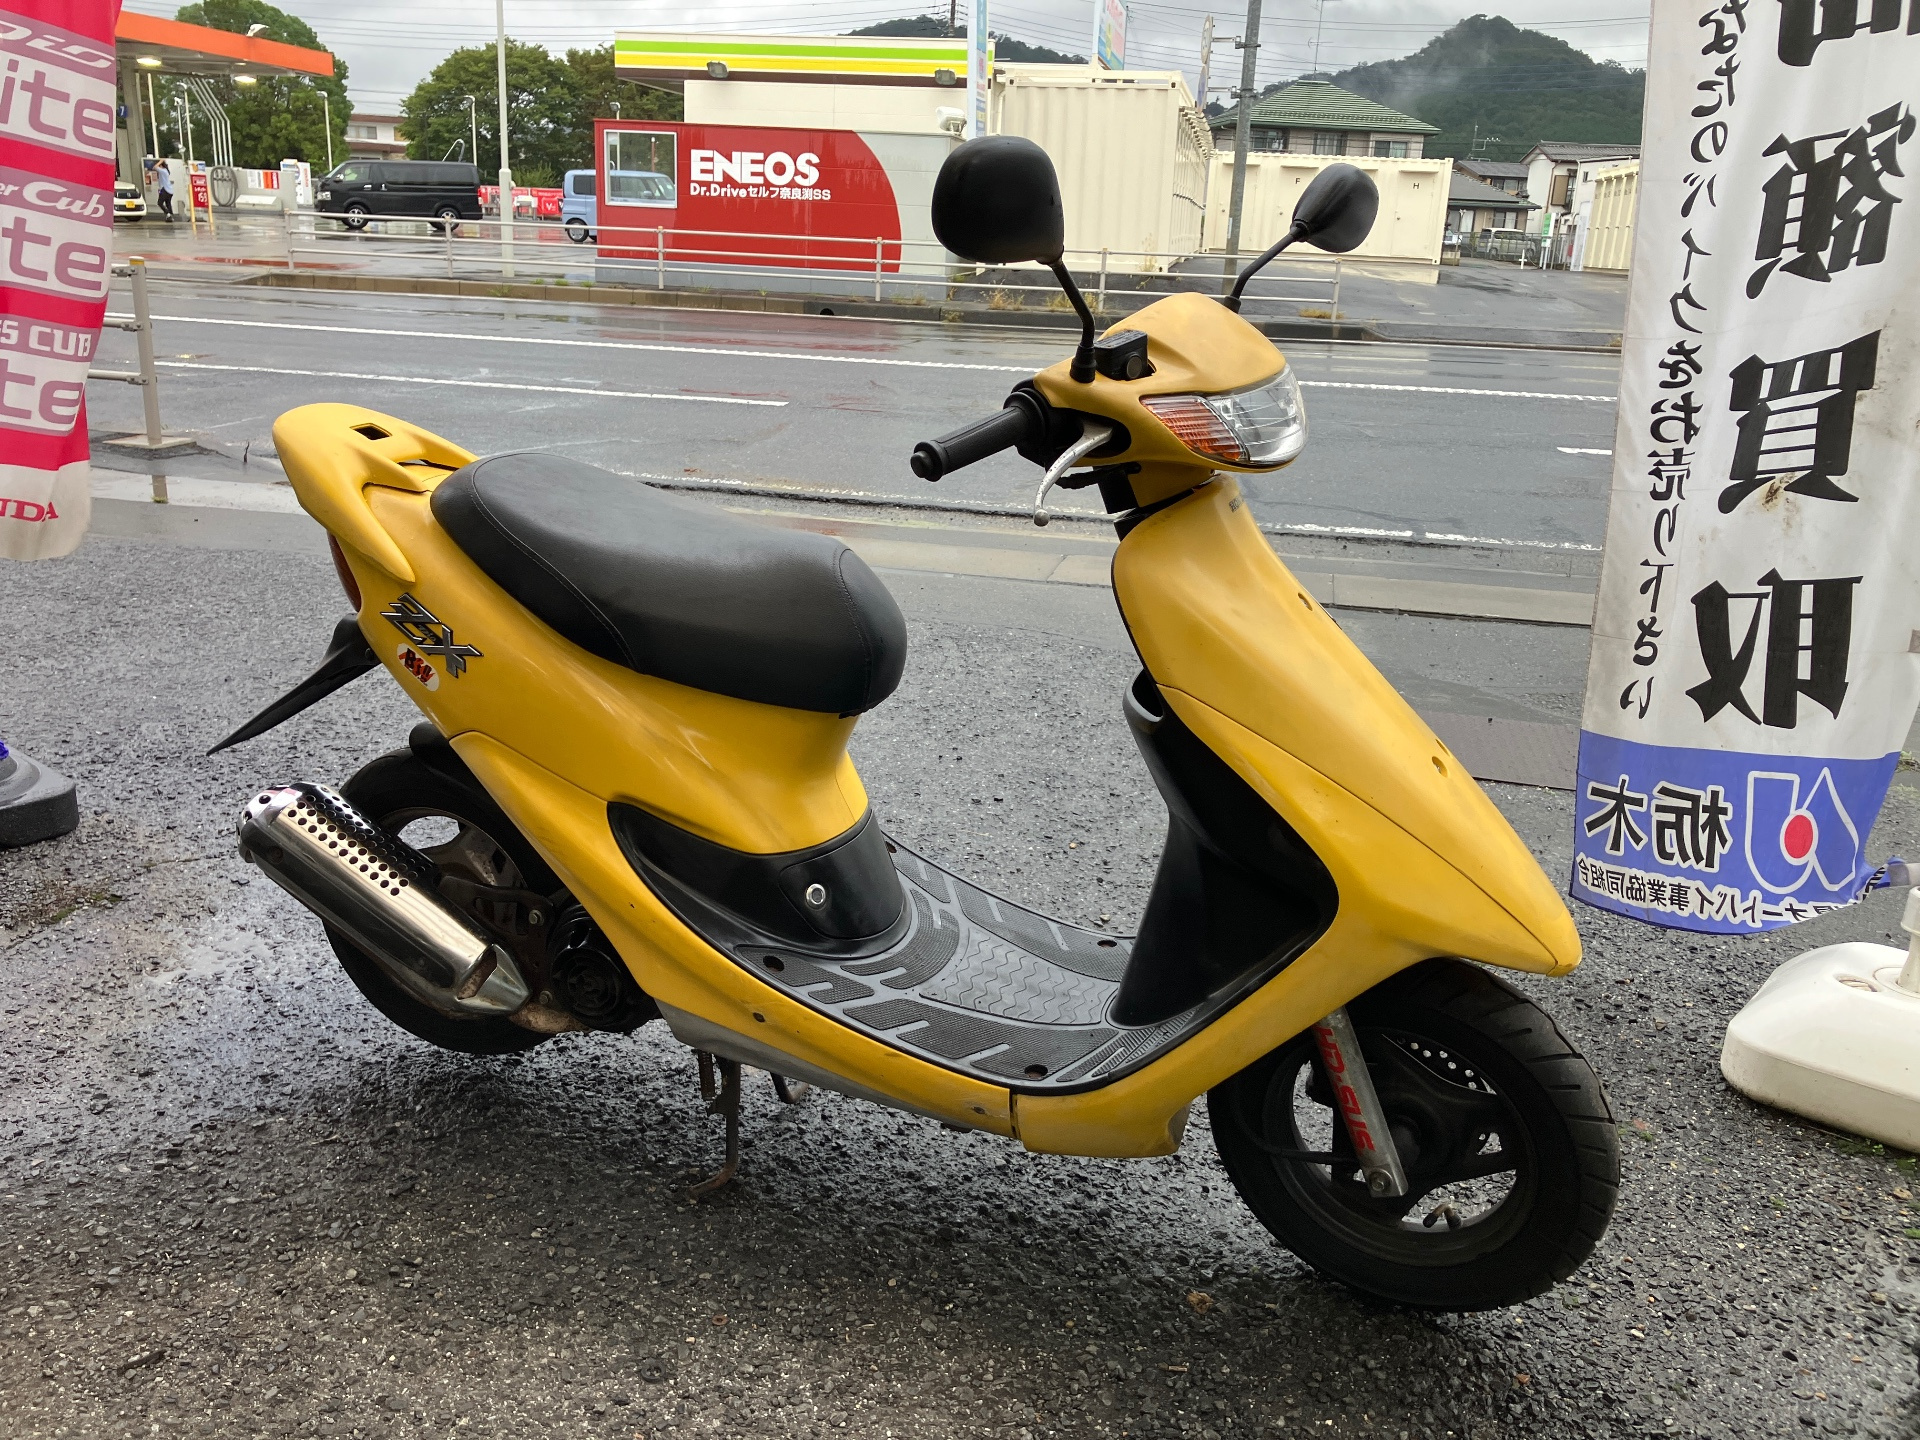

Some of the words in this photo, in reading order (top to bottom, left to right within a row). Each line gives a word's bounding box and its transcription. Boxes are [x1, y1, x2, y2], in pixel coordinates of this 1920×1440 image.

[690, 148, 820, 187] ENEOS
[1412, 182, 1420, 190] H
[22, 181, 105, 218] Cub
[379, 592, 484, 679] ZX
